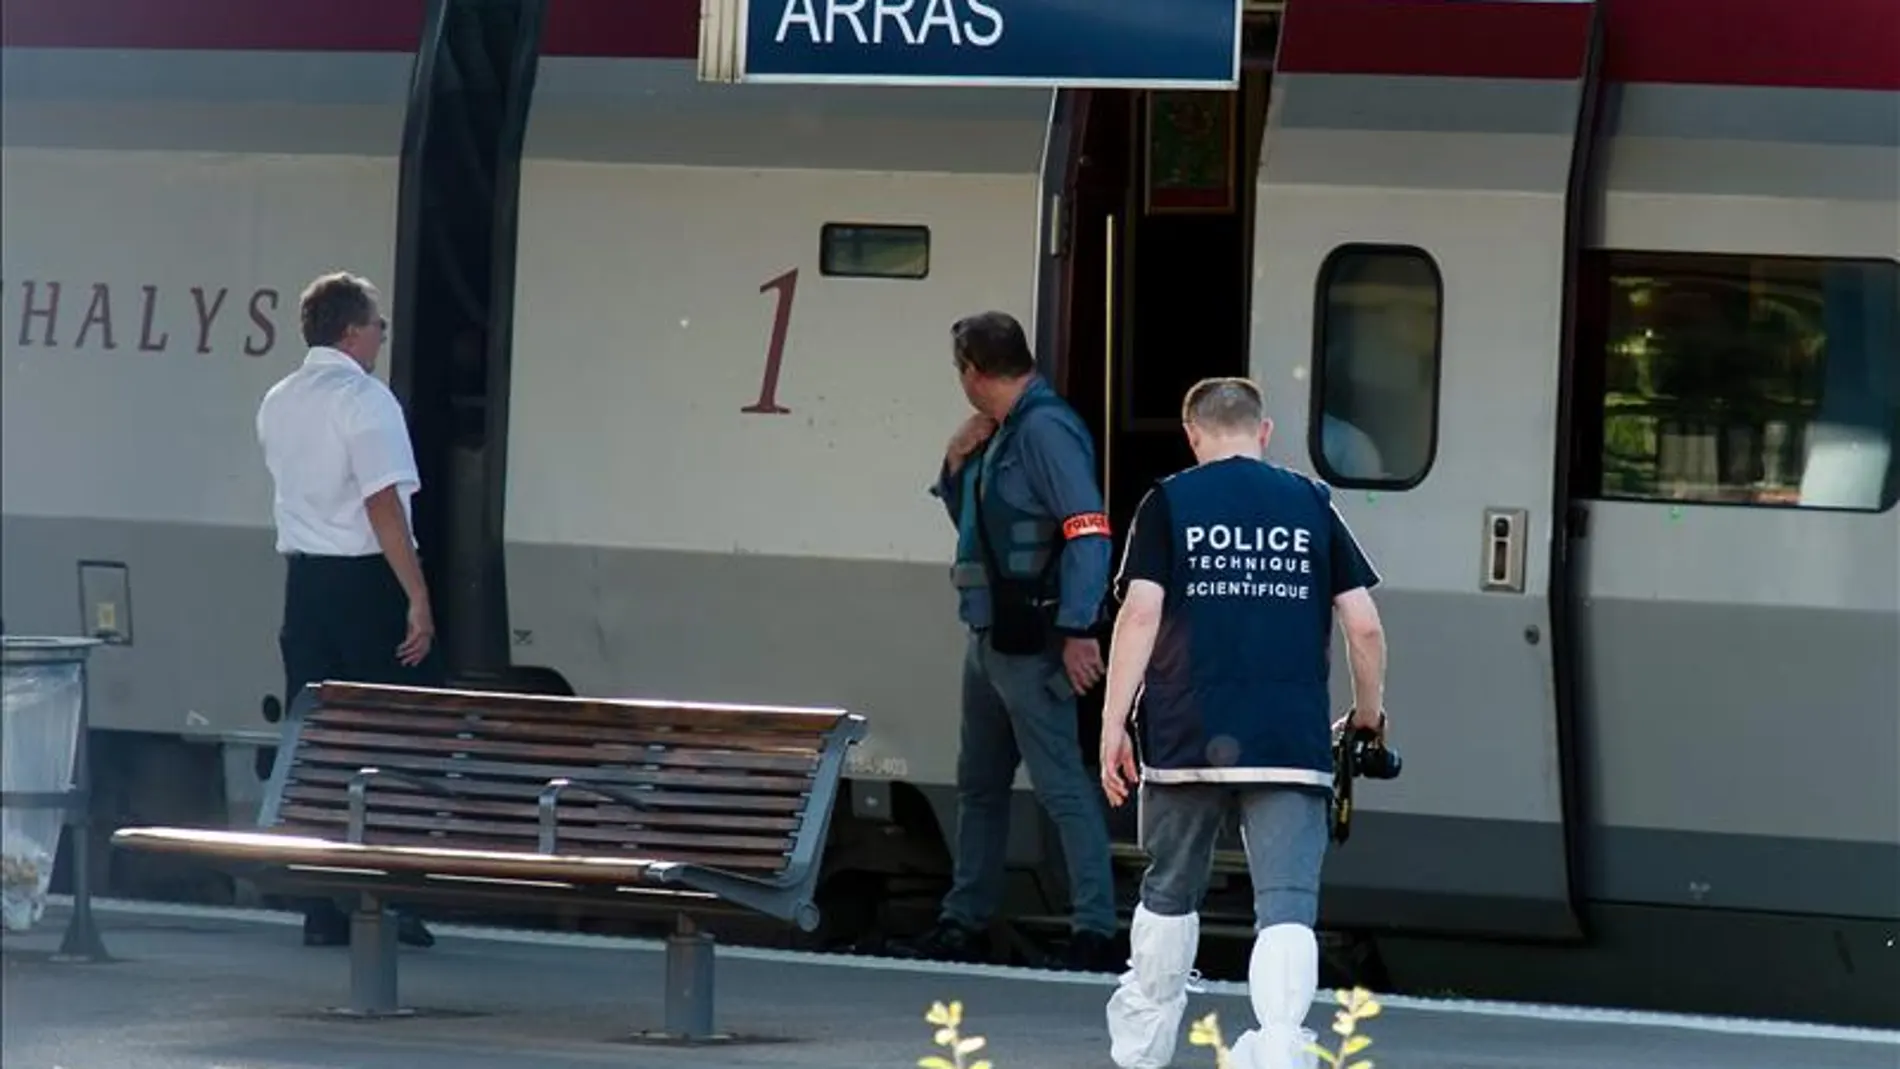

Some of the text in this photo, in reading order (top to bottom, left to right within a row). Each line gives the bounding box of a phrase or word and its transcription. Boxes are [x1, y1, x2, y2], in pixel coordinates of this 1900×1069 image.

[775, 0, 1004, 46] ARRAS
[0, 280, 280, 357] HALYS
[741, 267, 799, 414] 1
[1186, 524, 1311, 553] POLICE
[1187, 555, 1311, 573] TECHNIQUE
[1186, 581, 1309, 599] SCIENTIFIQUE
